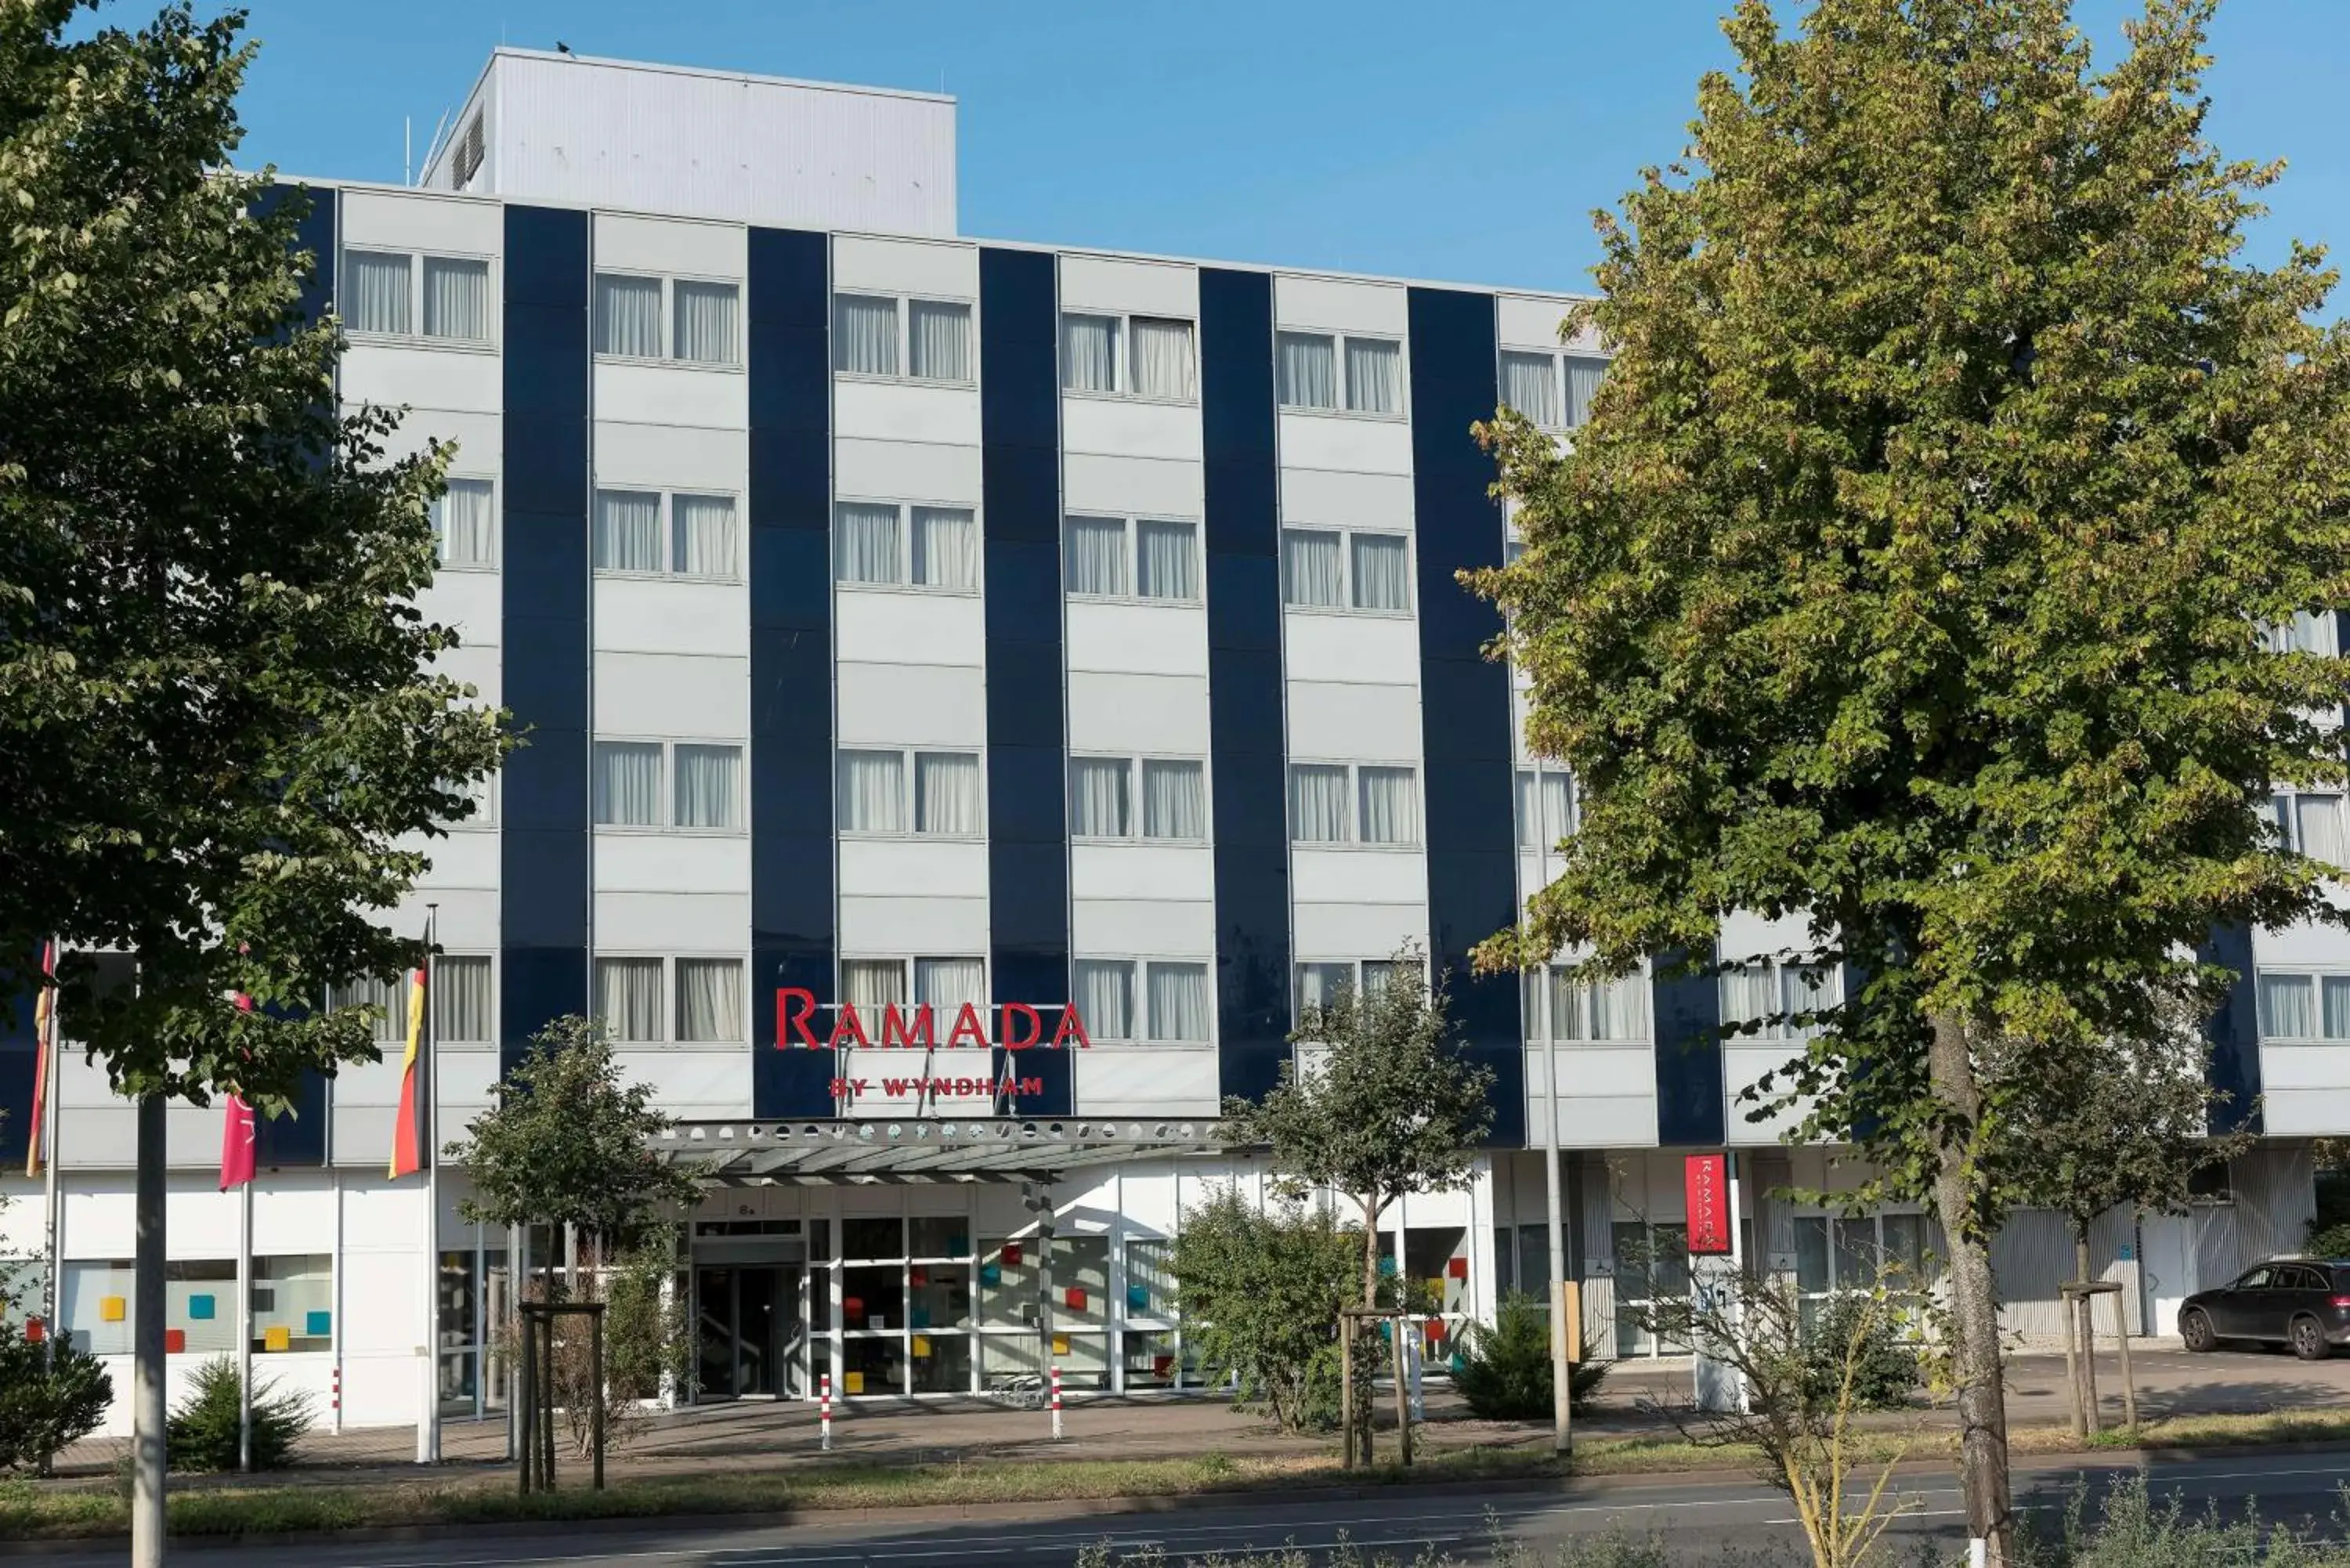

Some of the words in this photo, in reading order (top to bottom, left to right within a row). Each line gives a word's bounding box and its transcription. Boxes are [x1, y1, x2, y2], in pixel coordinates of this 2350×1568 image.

[776, 988, 1090, 1050] RAMADA
[830, 1078, 867, 1097] BY
[883, 1077, 1043, 1097] WYNDHAM
